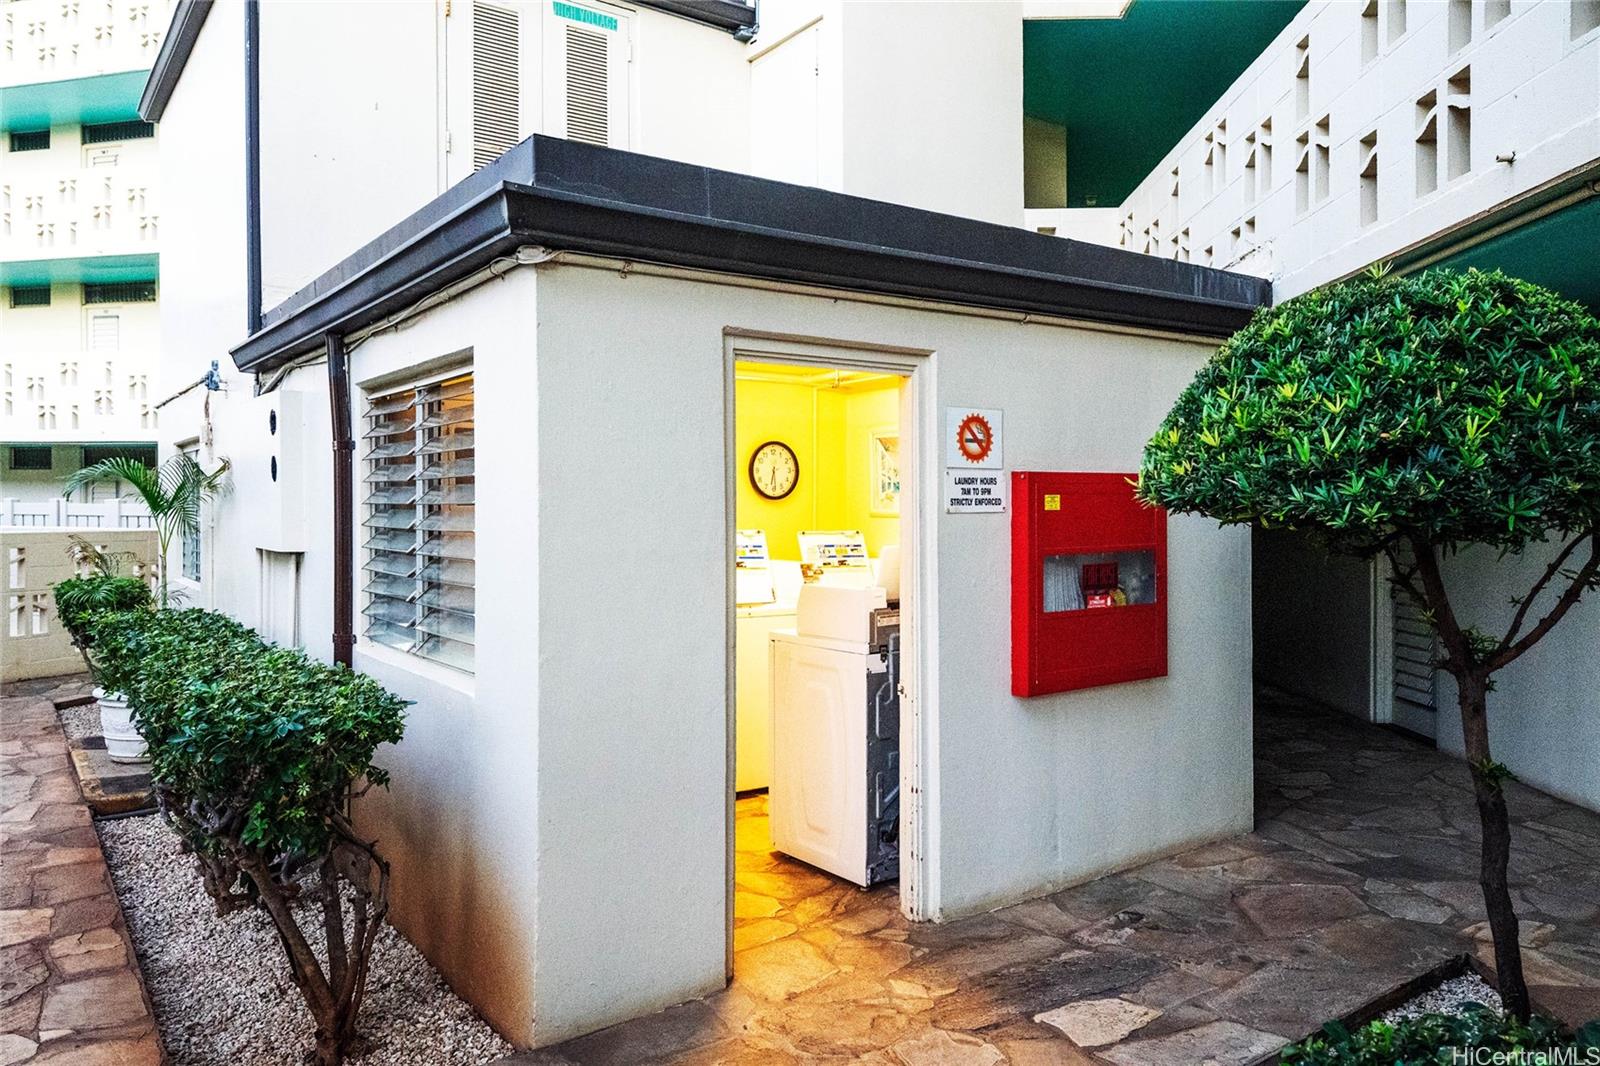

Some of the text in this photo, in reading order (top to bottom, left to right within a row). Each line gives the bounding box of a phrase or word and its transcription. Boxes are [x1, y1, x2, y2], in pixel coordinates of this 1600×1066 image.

[553, 2, 617, 31] HIGH VOLTAGE
[954, 477, 997, 485] LAUNDRY HOURS
[950, 498, 1002, 506] STRICTLY ENFORCED
